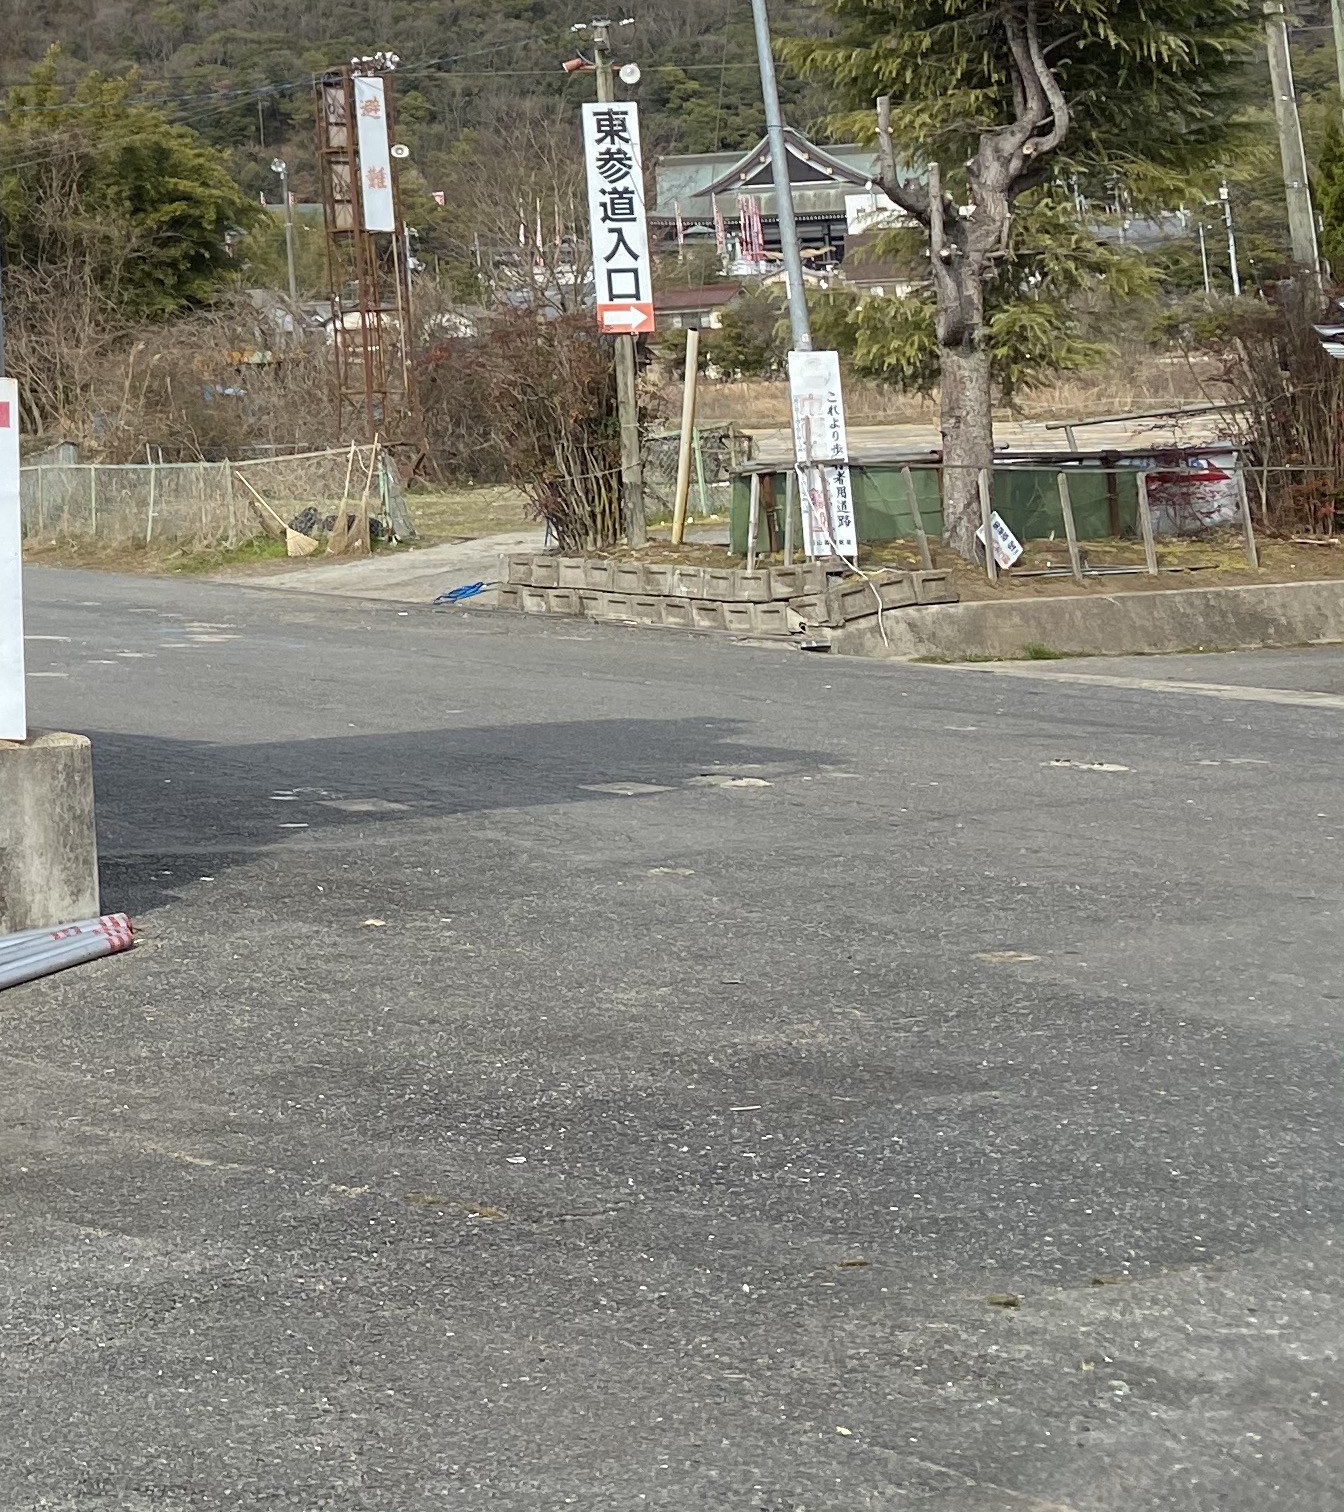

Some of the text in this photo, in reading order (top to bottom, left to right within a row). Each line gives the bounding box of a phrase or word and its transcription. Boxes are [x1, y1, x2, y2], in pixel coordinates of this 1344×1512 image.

[592, 108, 643, 303] 東参道入口
